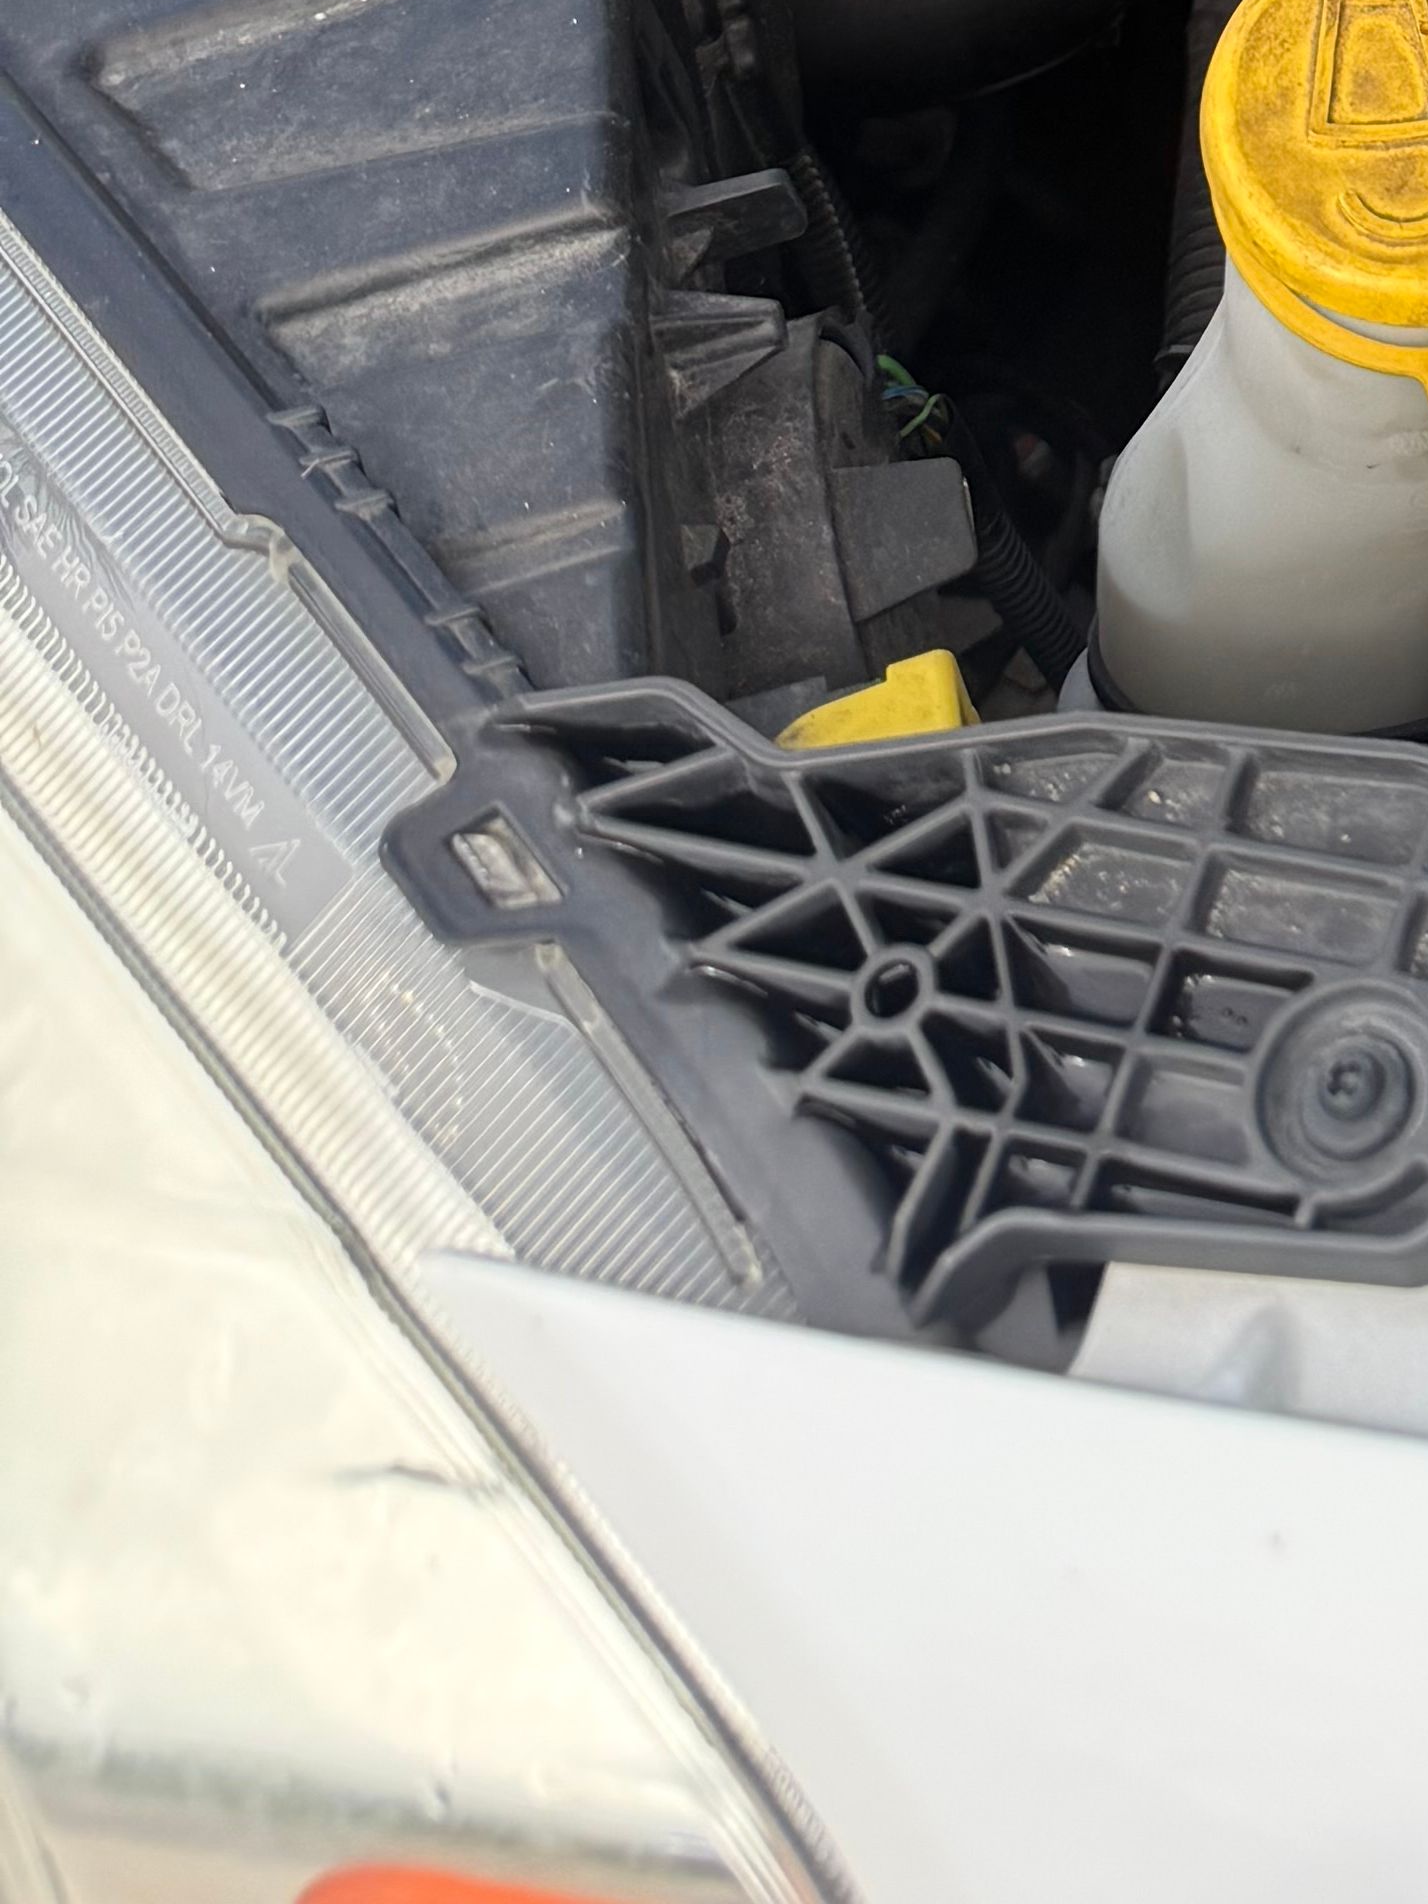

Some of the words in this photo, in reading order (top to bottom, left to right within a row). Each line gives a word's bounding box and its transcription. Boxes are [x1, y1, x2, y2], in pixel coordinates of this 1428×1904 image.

[15, 494, 63, 561] SAE
[52, 545, 92, 602] HR
[155, 680, 203, 756] DRL
